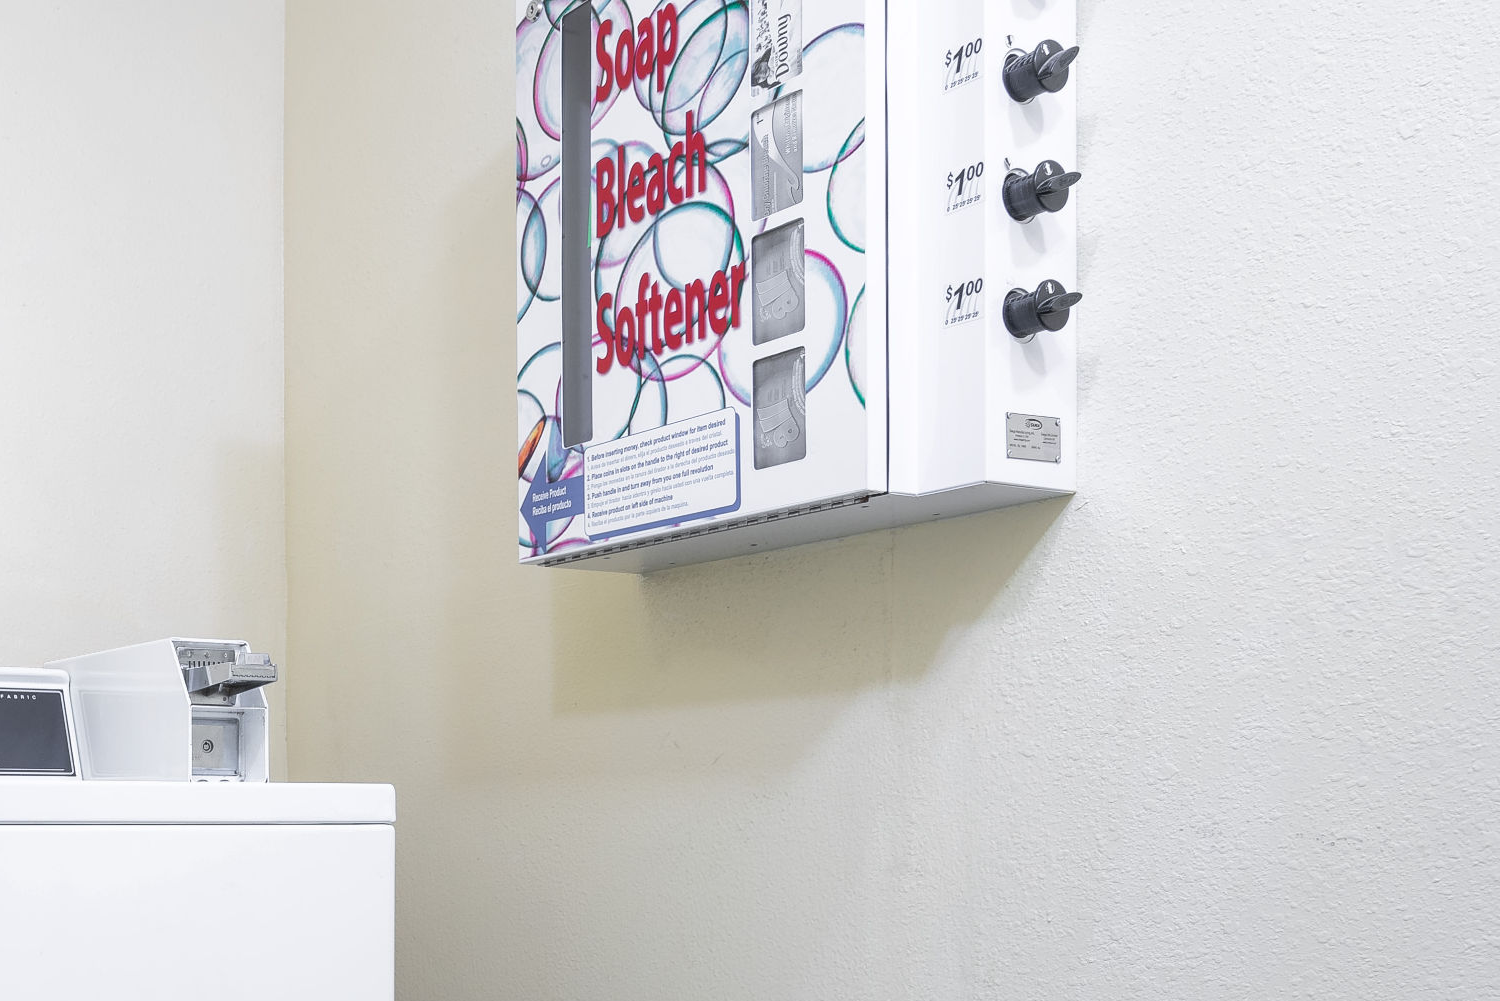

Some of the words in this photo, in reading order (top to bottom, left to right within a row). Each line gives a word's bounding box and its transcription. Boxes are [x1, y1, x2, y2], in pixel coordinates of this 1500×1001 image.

[596, 4, 677, 101] Soap
[597, 112, 705, 237] Bleach
[597, 263, 744, 373] Softener
[591, 453, 604, 461] Before
[605, 448, 623, 457] inserting
[639, 439, 652, 448] check
[653, 434, 670, 445] product
[671, 430, 688, 439] window
[708, 418, 725, 429] desired
[645, 457, 659, 466] handle
[674, 450, 684, 460] right
[691, 443, 708, 454] desired
[709, 439, 728, 451] product
[549, 486, 567, 499] Product
[591, 491, 602, 499] Push
[603, 488, 616, 496] handle
[663, 475, 671, 483] you
[681, 469, 689, 477] full
[690, 465, 713, 474] revolution
[592, 510, 607, 518] Receive
[608, 505, 624, 515] product
[654, 495, 673, 503] machine
